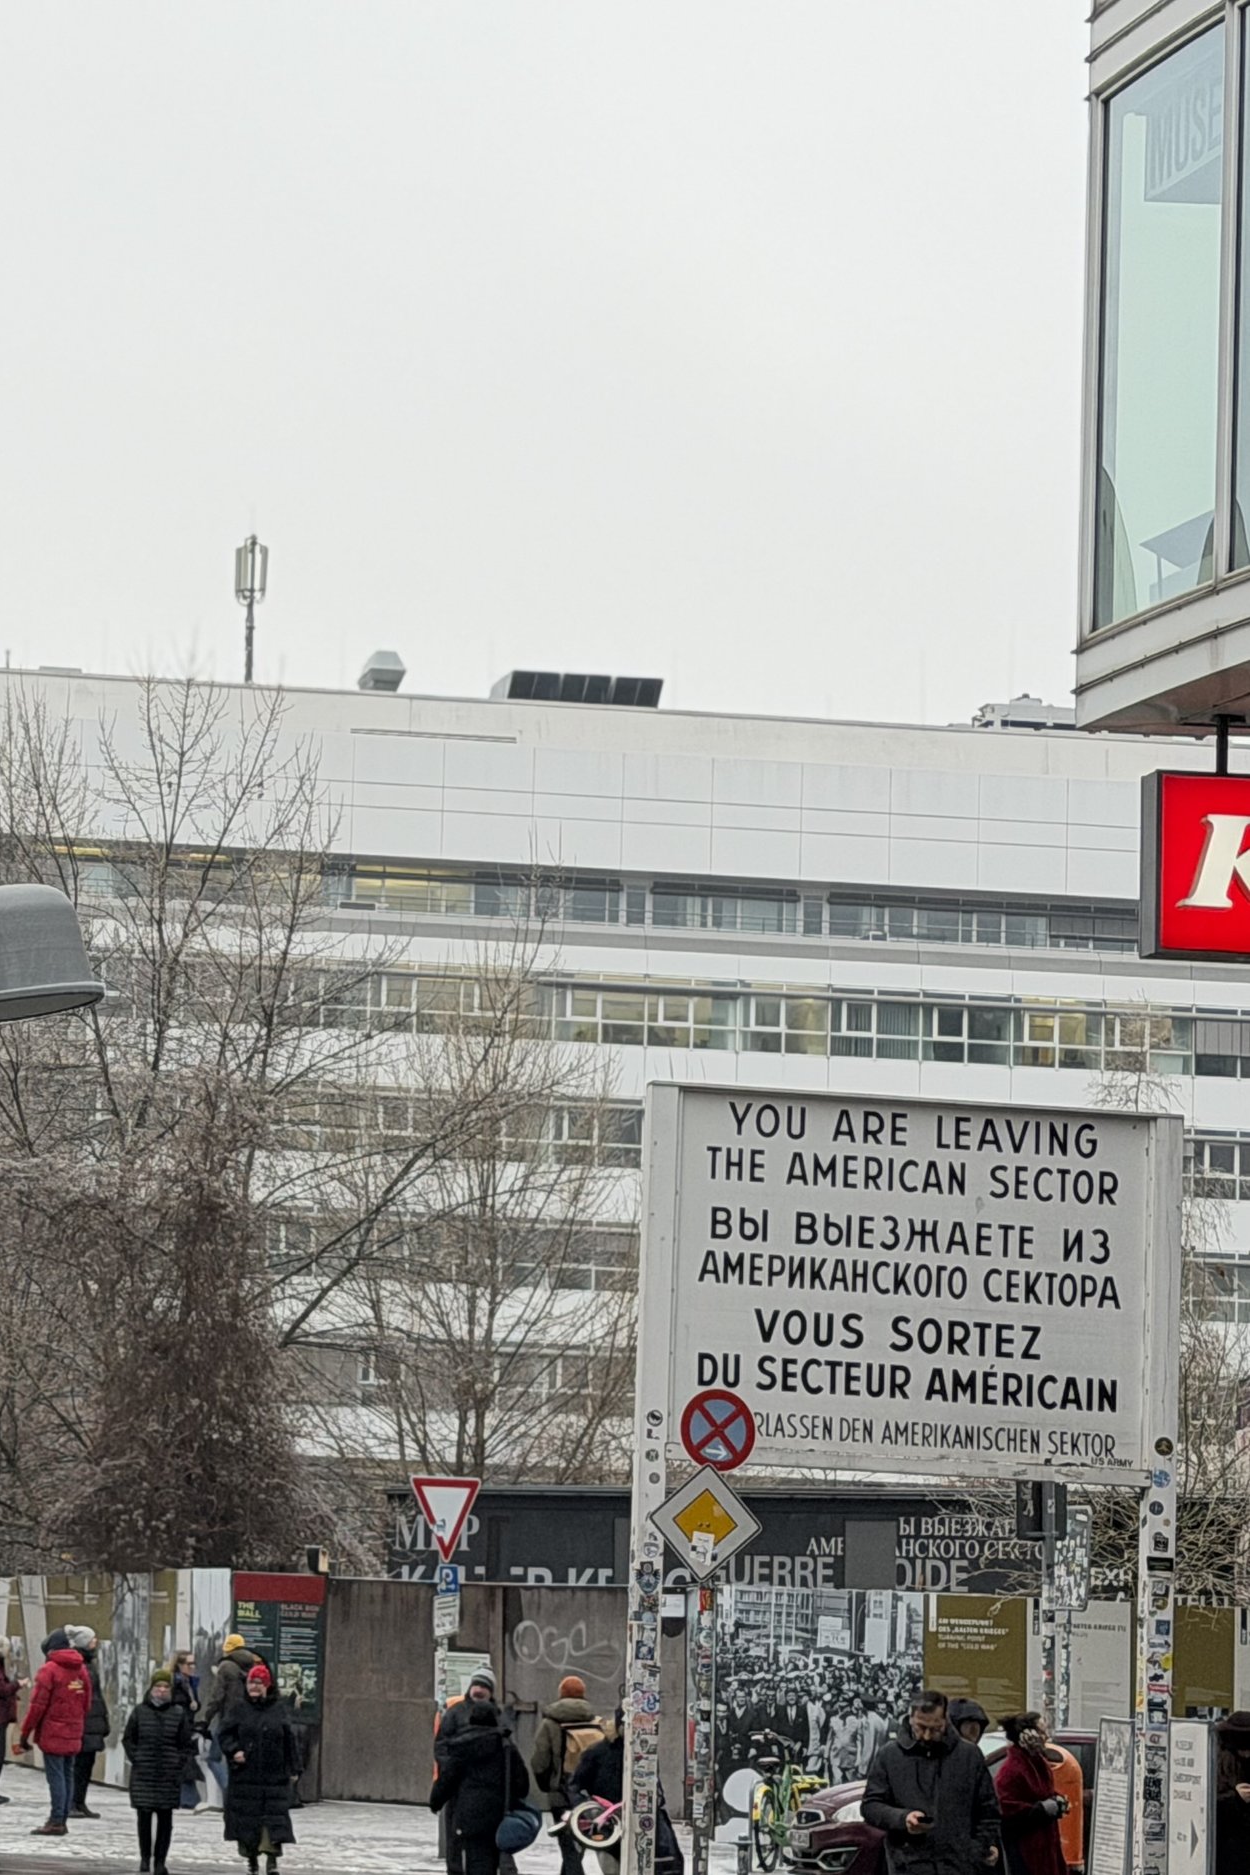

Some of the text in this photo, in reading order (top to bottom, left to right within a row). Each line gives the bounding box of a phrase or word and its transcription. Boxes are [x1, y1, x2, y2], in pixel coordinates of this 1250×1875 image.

[729, 1101, 1097, 1159] YOU ARE LEAVING
[707, 1146, 1118, 1205] THE AMERICAN SECTOR
[711, 1207, 1110, 1264] ВЫ ВЫЕЗЖАЕТЕ ИЗ
[699, 1251, 1120, 1309] АМЕРИКАНСКОГО СЕКТОРА
[755, 1309, 1041, 1360] VOUS SORTEZ
[698, 1353, 1117, 1412] DU SECTEUR AMÉRICAIN
[754, 1412, 1115, 1458] RLASSEN DEN AMERIKANISCHEN SEKTOR
[1091, 1457, 1133, 1468] US ARMY
